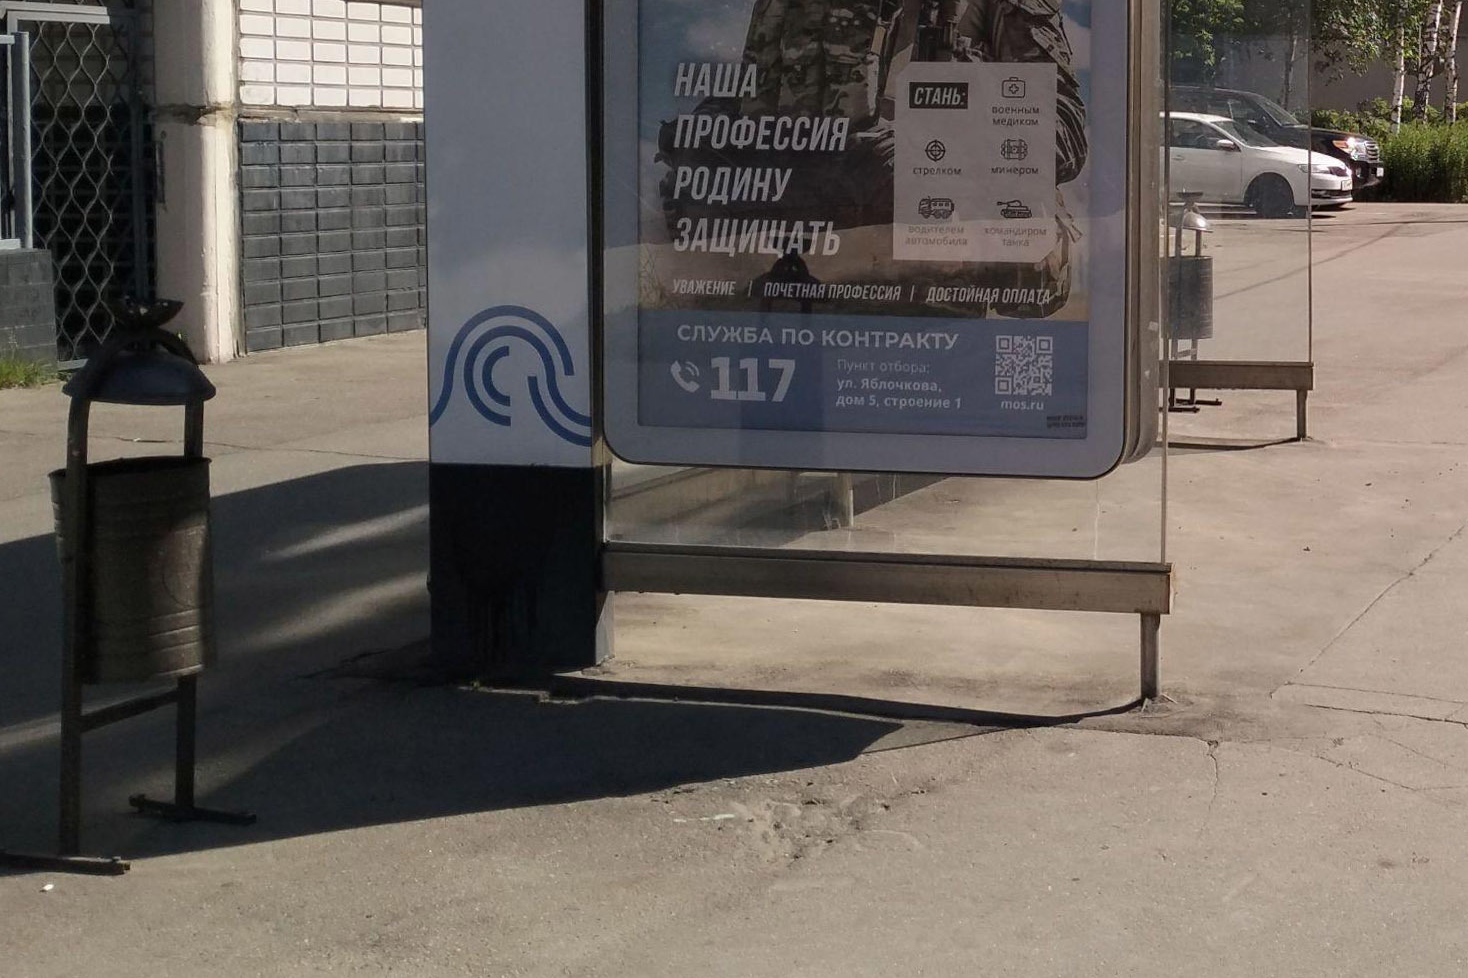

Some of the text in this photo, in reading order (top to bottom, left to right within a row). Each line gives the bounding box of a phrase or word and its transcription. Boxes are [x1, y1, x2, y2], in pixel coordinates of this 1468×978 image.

[674, 62, 758, 98] НАША
[914, 86, 966, 106] СТАНЬ:
[991, 105, 1040, 114] военным
[992, 117, 1039, 126] медиком
[673, 114, 850, 151] ПРОФЕССИЯ
[912, 166, 962, 176] стрелком
[990, 166, 1039, 176] минером
[672, 166, 792, 205] РОДИНУ
[673, 217, 841, 257] ЗАЩИЩАТЬ
[672, 279, 736, 296] УВАЖЕНИЕ
[763, 282, 901, 301] ПОЧЕТНАЯ ПРОФЕССИЯ
[925, 285, 1051, 306] ДОСТОЙНАЯ ОПЛАТА
[677, 324, 959, 350] СЛУЖБА ПО КОНТРАКТУ
[837, 359, 930, 375] Пункт отбора:
[710, 356, 797, 403] 117
[837, 378, 942, 393] ул. Яблочкова,
[836, 395, 865, 409] дом
[868, 394, 880, 410] 5,
[884, 397, 951, 409] строение
[1000, 398, 1044, 411] mos.ru
